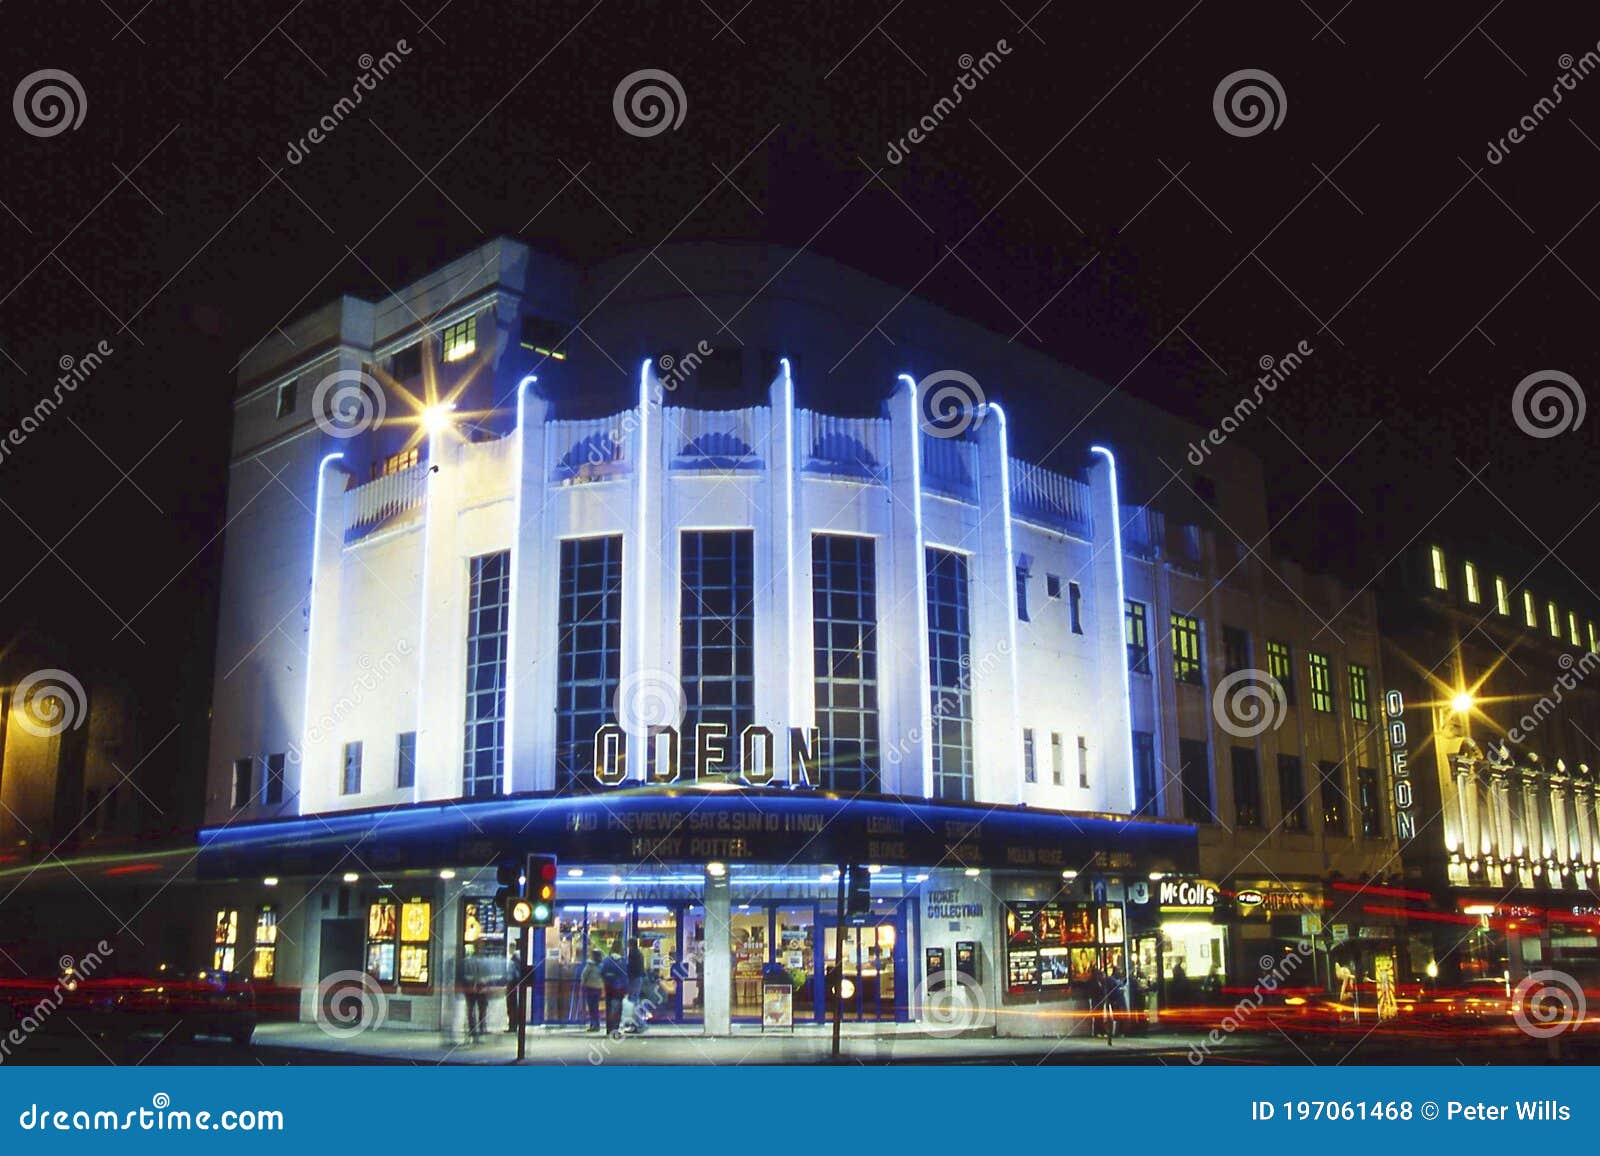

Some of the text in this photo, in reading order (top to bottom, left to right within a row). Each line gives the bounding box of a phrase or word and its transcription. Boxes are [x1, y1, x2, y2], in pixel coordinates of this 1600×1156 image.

[594, 723, 821, 785] ODEON
[1386, 690, 1416, 839] ODEON
[608, 813, 682, 831] PREVIEWS
[632, 837, 682, 856] HARRY
[928, 888, 960, 903] TICKET
[928, 902, 984, 919] COLLECTION
